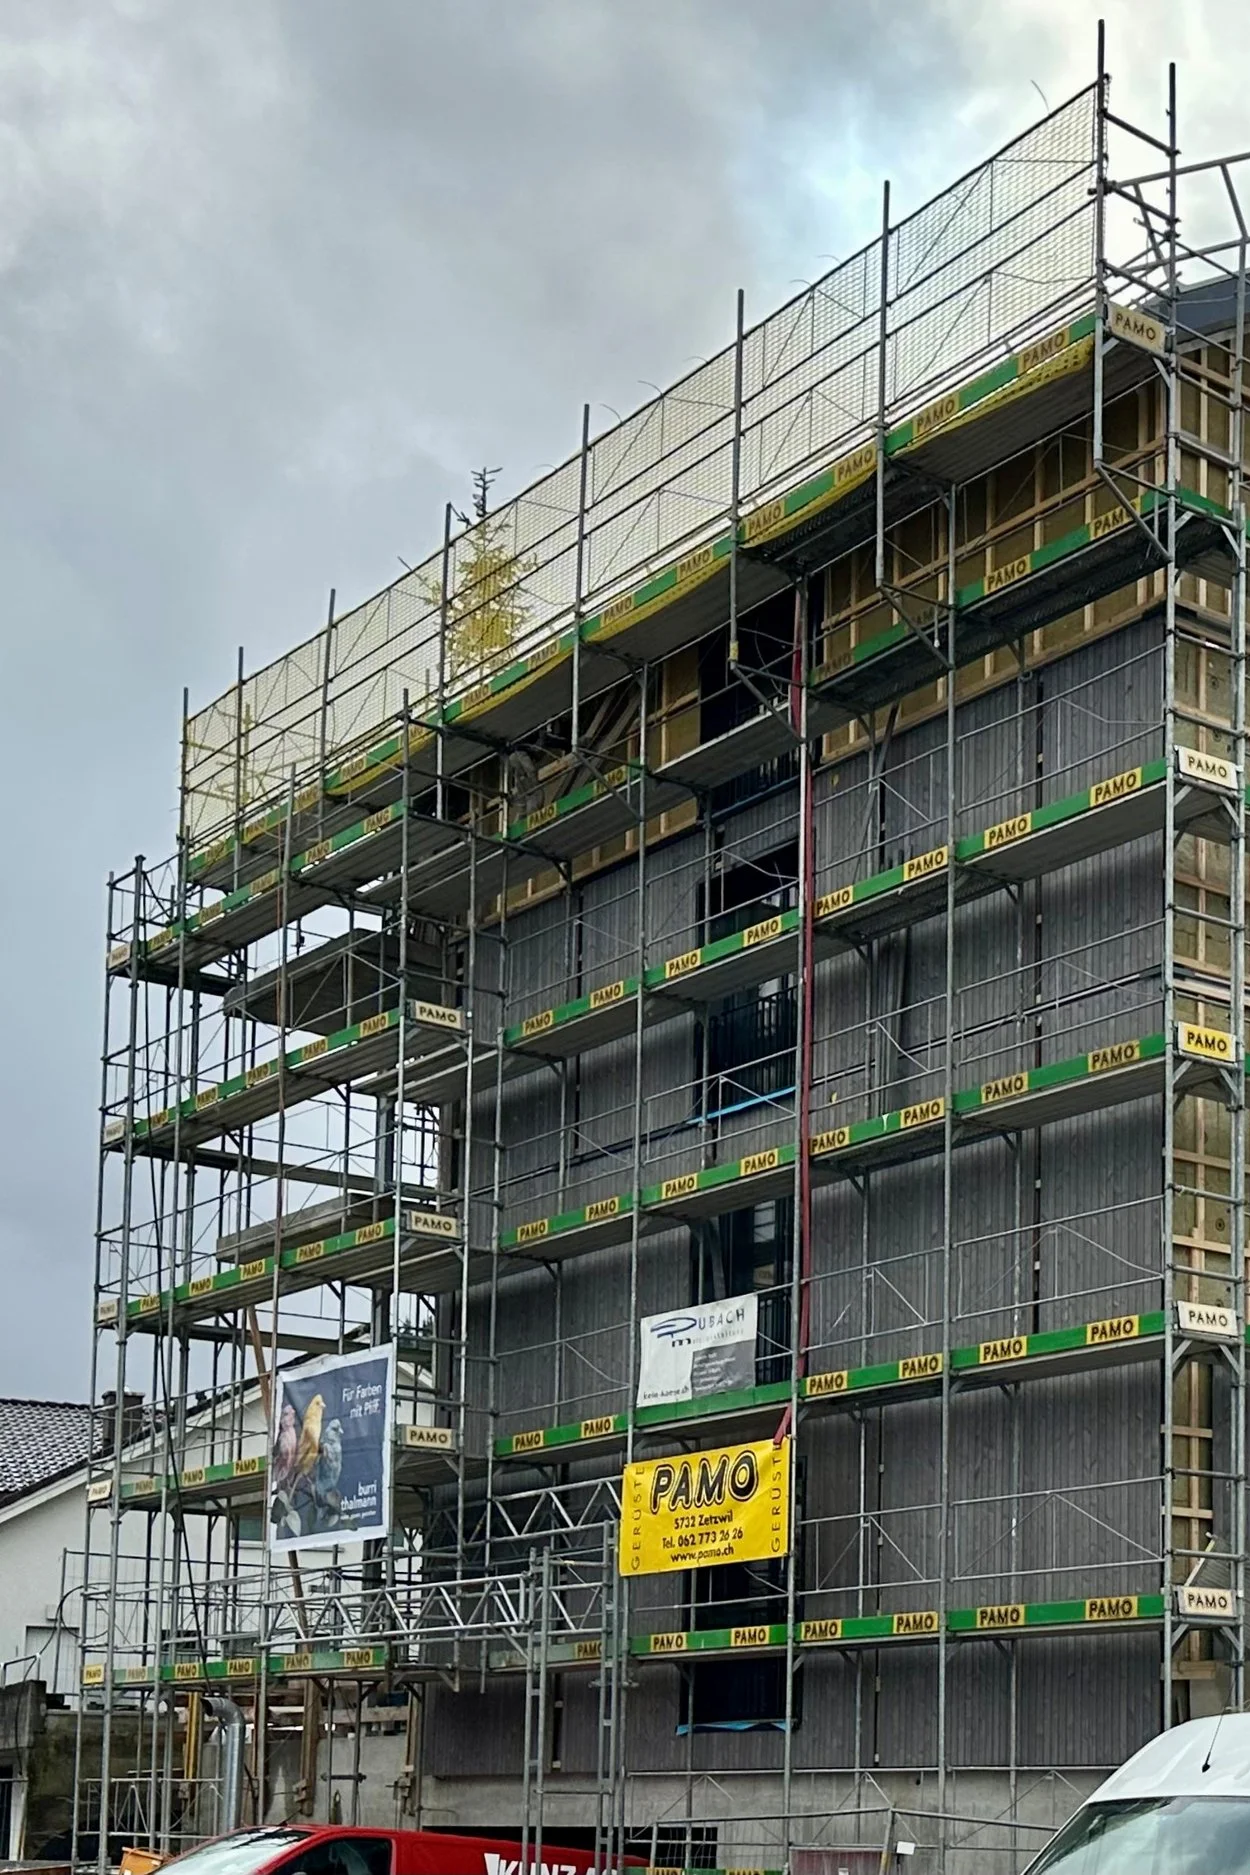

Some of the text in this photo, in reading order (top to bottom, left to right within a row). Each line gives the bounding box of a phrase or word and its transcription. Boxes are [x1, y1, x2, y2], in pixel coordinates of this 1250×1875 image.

[1116, 312, 1156, 341] PAMO
[1023, 334, 1066, 364] PAMO
[917, 399, 955, 430] PAMO
[838, 450, 872, 479] PAMO
[749, 506, 781, 532] PAMO
[988, 562, 1026, 587] PAMO
[1188, 756, 1227, 778] PAMO
[1095, 774, 1136, 801] PAMO
[529, 806, 554, 826] PAMO
[989, 819, 1027, 843] PAMO
[908, 852, 944, 876] PAMO
[818, 891, 850, 915] PAMO
[748, 920, 778, 941] PAMO
[668, 953, 698, 974] PAMO
[593, 985, 621, 1006] PAMO
[420, 1007, 456, 1022] PAMO
[525, 1014, 550, 1033] PAMO
[362, 1017, 386, 1035] PAMO
[1188, 1032, 1227, 1051] PAMO
[1092, 1046, 1135, 1068] PAMO
[985, 1077, 1024, 1100] PAMO
[904, 1102, 940, 1124] PAMO
[813, 1130, 845, 1151] PAMO
[745, 1153, 775, 1173] PAMO
[666, 1177, 695, 1196] PAMO
[589, 1200, 617, 1218] PAMO
[358, 1225, 381, 1241] PAMO
[415, 1216, 452, 1231] PAMO
[520, 1222, 546, 1238] PAMO
[299, 1245, 322, 1261] PAMO
[191, 1278, 211, 1293] PAMO
[1189, 1310, 1228, 1327] PAMO
[1091, 1319, 1134, 1341] PAMO
[983, 1341, 1022, 1361] PAMO
[902, 1357, 938, 1376] PAMO
[810, 1372, 844, 1393] PAMO
[584, 1418, 610, 1434] PAMO
[411, 1430, 447, 1443] PAMO
[515, 1434, 540, 1450] PAMO
[236, 1461, 256, 1473] PAMO
[184, 1470, 203, 1485] PAMO
[650, 1450, 759, 1515] PAMO
[674, 1510, 733, 1530] 5732 Zetzwil
[662, 1526, 743, 1549] Tel. 062 773 26 26
[670, 1542, 735, 1564] www.pamo.ch
[1089, 1600, 1132, 1618] PAMO
[1188, 1594, 1227, 1608] PAMO
[897, 1616, 934, 1631] PAMO
[980, 1608, 1020, 1625] PAMO
[733, 1628, 766, 1645] PAMO
[804, 1623, 837, 1638] PAMO
[230, 1662, 249, 1674] PAMO
[346, 1653, 370, 1665] PAMO
[177, 1666, 196, 1678] PAMO
